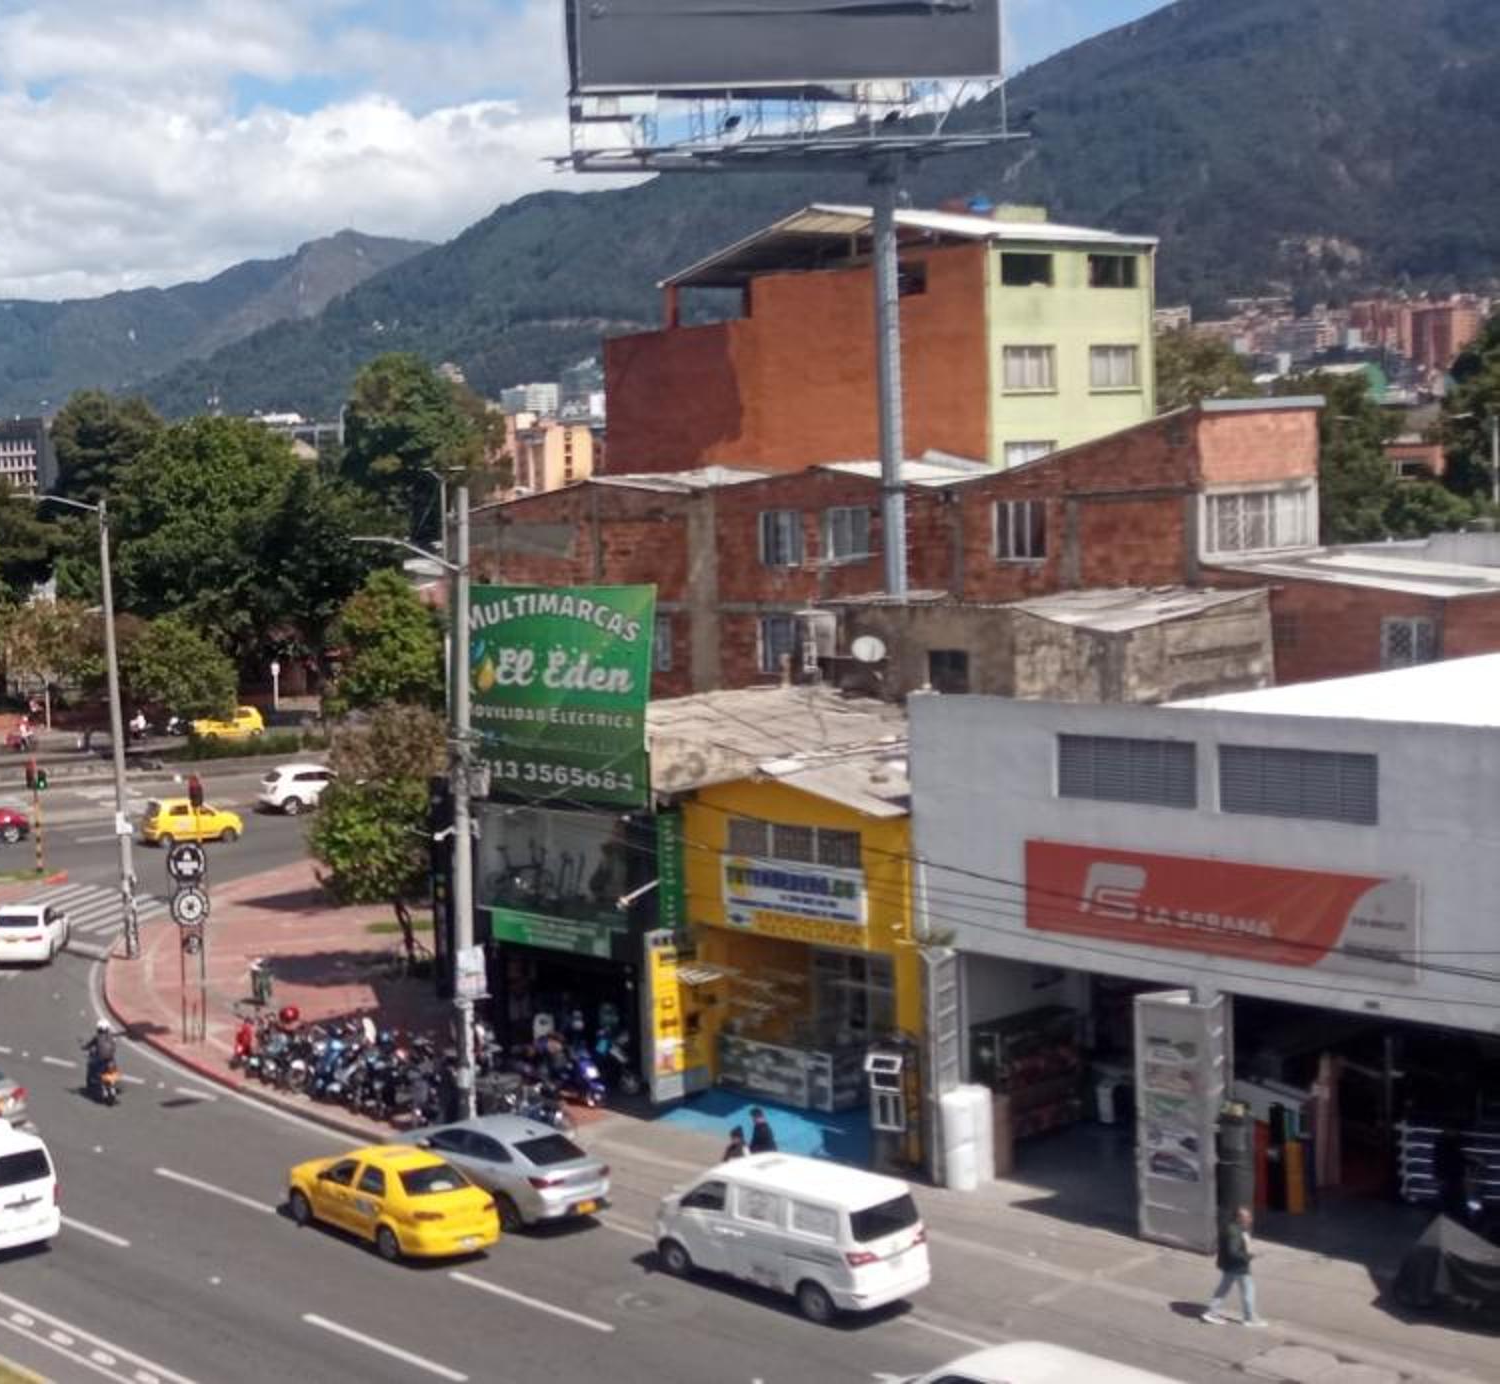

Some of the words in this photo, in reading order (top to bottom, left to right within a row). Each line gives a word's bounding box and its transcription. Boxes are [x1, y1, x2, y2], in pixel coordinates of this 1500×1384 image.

[469, 593, 641, 642] MULTIMARCAS
[496, 647, 534, 687] El
[542, 648, 634, 692] Eden
